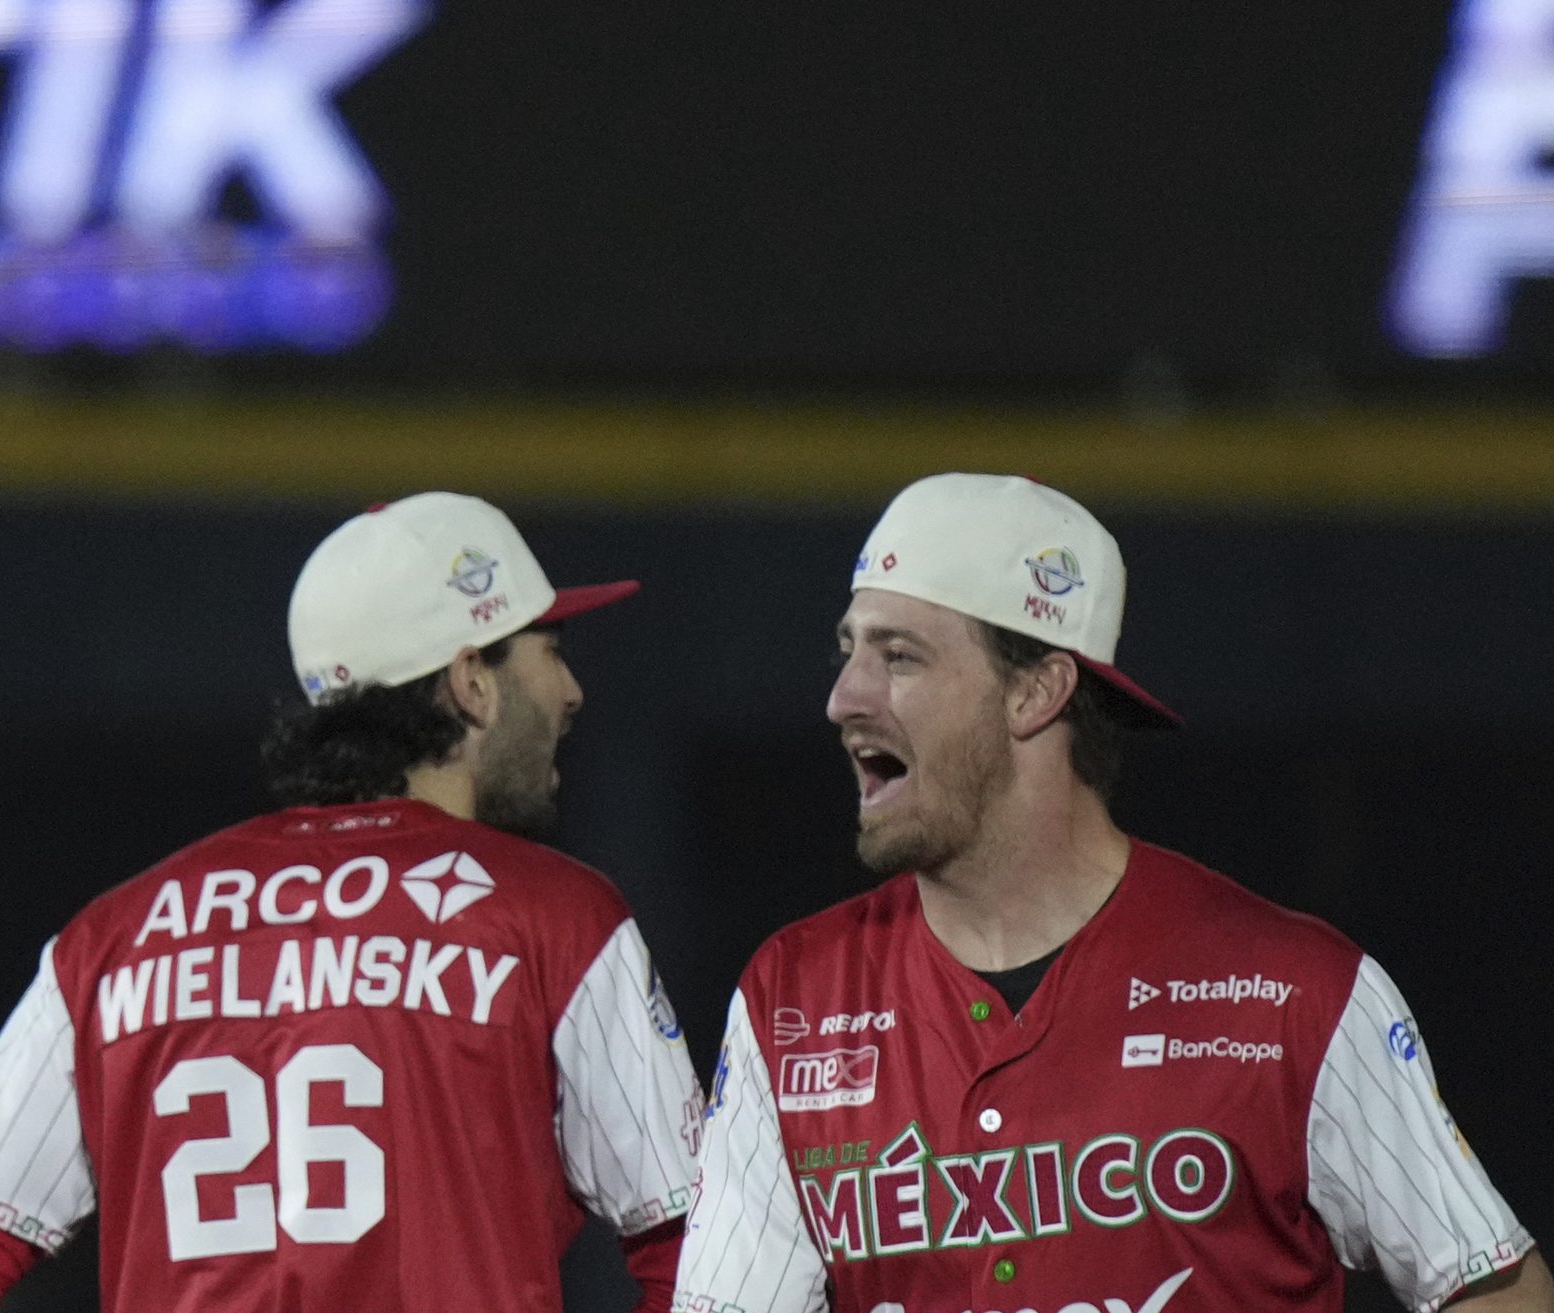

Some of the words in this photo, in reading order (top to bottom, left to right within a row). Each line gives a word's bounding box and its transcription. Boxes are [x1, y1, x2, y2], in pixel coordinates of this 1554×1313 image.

[134, 854, 389, 947] ARCO
[97, 935, 520, 1044] WIELANSKY
[1166, 973, 1293, 1007] Totalplay
[153, 1044, 385, 1262] 26
[794, 1145, 835, 1171] LIGA
[842, 1140, 871, 1164] DE
[798, 1119, 1234, 1263] MÉXICO
